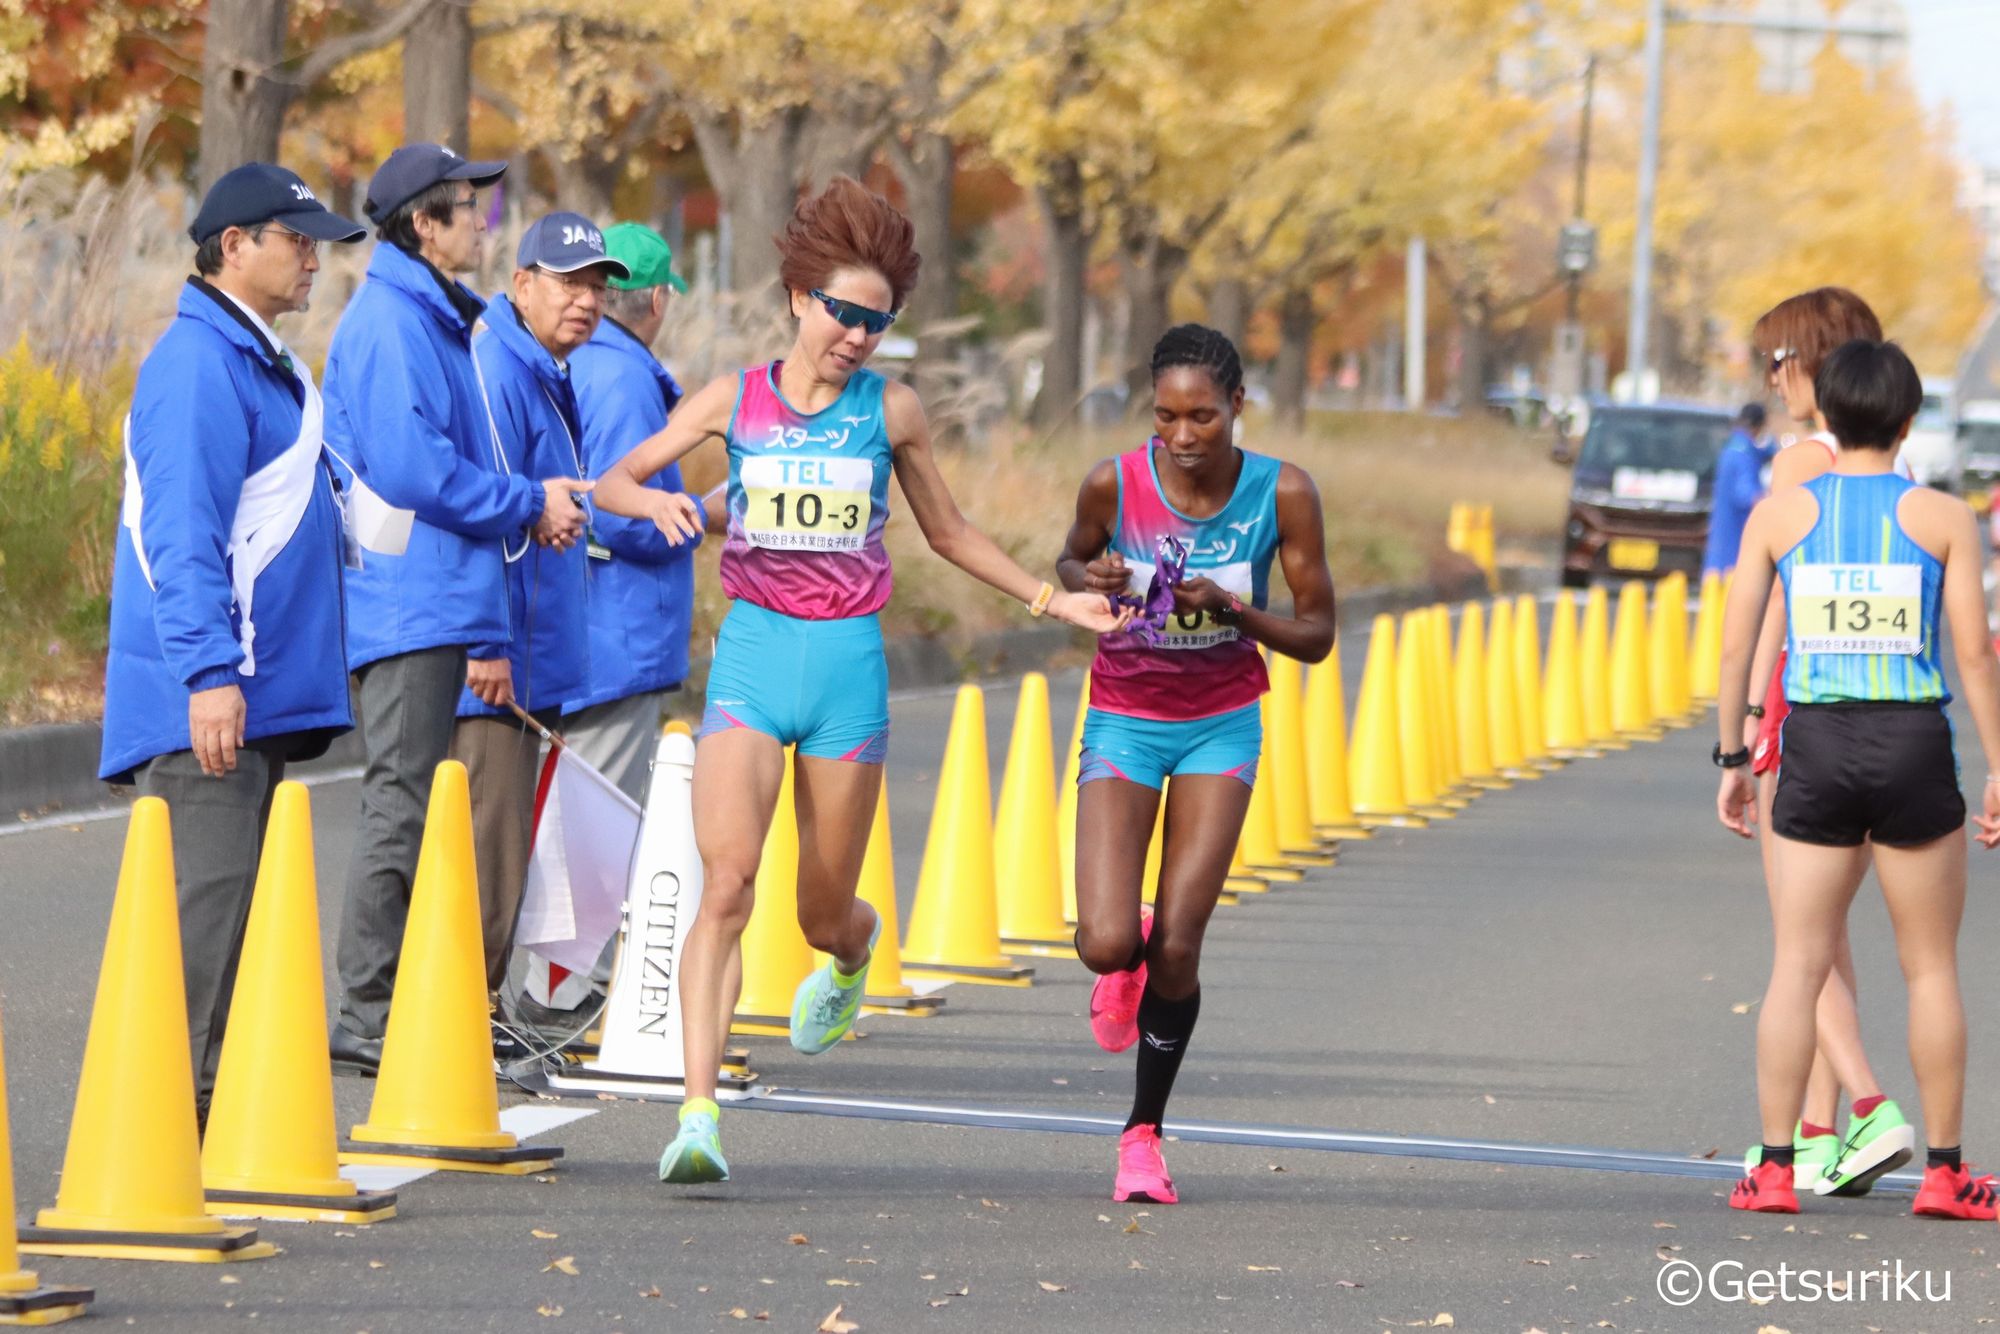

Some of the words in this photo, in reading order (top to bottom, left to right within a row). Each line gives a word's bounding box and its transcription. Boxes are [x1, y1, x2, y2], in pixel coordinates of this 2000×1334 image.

[764, 424, 850, 450] スターツ
[778, 459, 834, 486] TEL
[770, 492, 859, 531] 10-3
[1829, 569, 1883, 593] TEL
[1822, 599, 1909, 633] 13-4
[637, 870, 681, 1040] CITIZEN
